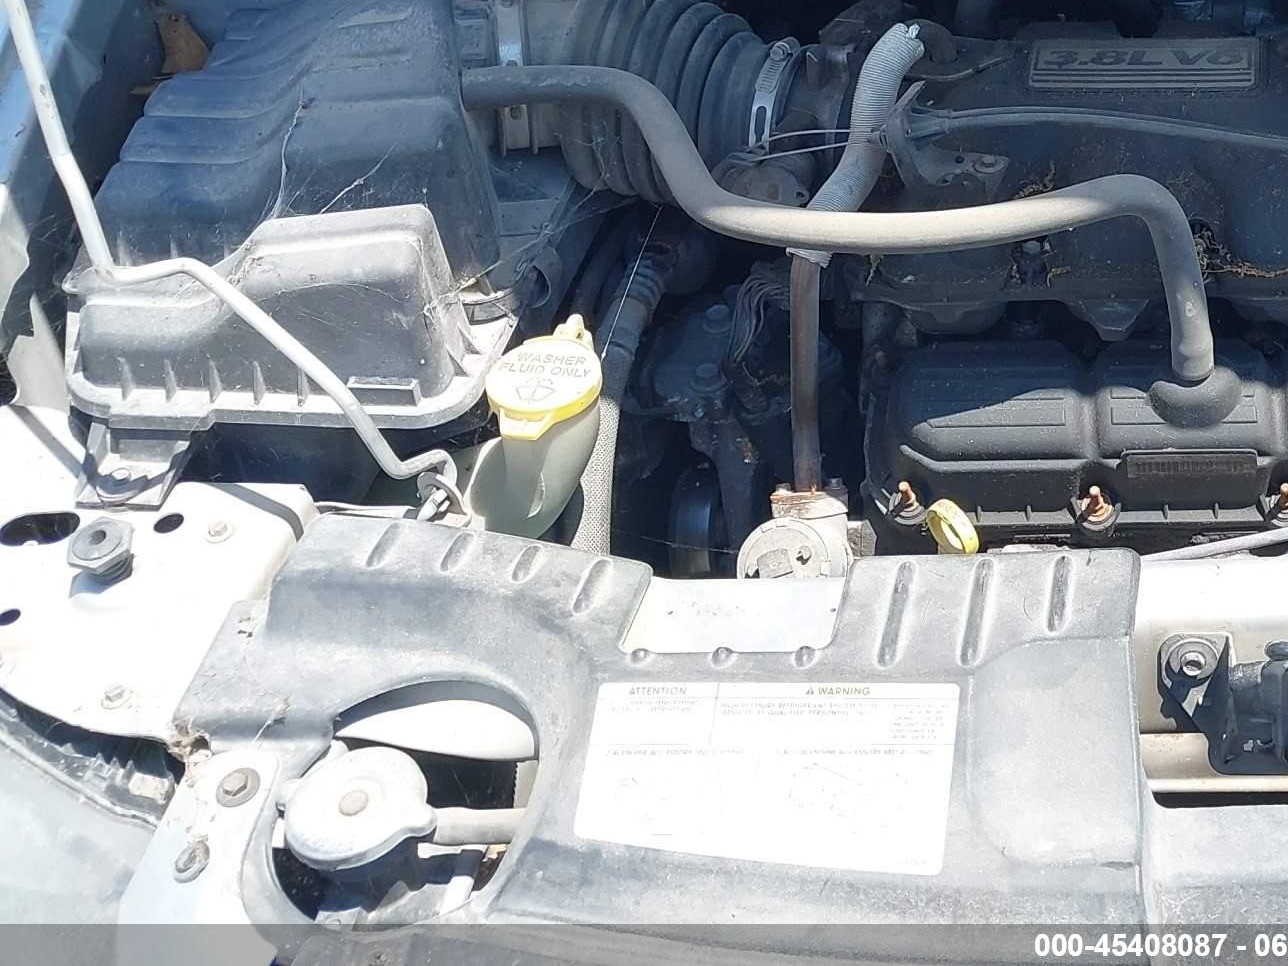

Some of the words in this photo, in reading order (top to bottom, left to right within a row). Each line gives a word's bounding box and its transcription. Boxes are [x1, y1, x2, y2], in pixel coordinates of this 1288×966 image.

[1043, 49, 1163, 68] 3.8L
[1169, 49, 1244, 67] V6
[517, 352, 587, 366] WASHER
[498, 362, 545, 374] FLUID
[549, 365, 592, 378] ONLY
[628, 686, 688, 696] ATTENTION
[817, 686, 871, 696] WARNING
